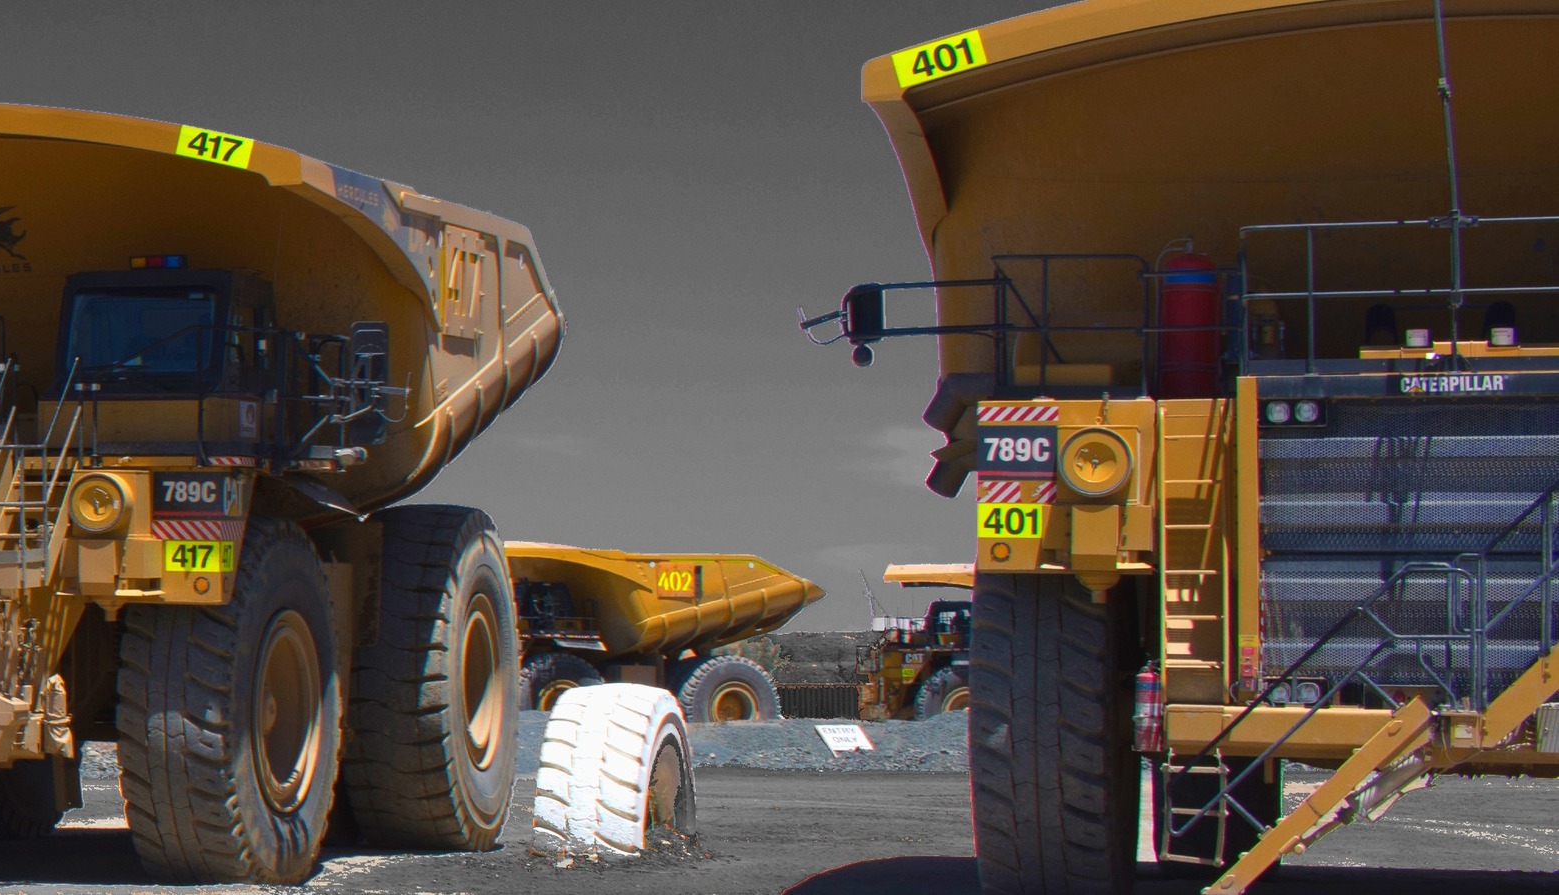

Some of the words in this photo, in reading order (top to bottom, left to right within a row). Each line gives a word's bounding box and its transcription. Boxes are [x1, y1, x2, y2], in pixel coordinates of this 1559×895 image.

[912, 38, 974, 77] 401
[187, 132, 243, 162] 417
[1400, 376, 1505, 393] CATERPILLAR
[983, 437, 1051, 462] 789C
[162, 480, 217, 503] 789C
[222, 475, 245, 517] CAT
[983, 507, 1039, 535] 401
[171, 544, 215, 569] 417
[658, 569, 692, 592] 402
[905, 653, 925, 664] CAT
[821, 727, 856, 735] ENTRY
